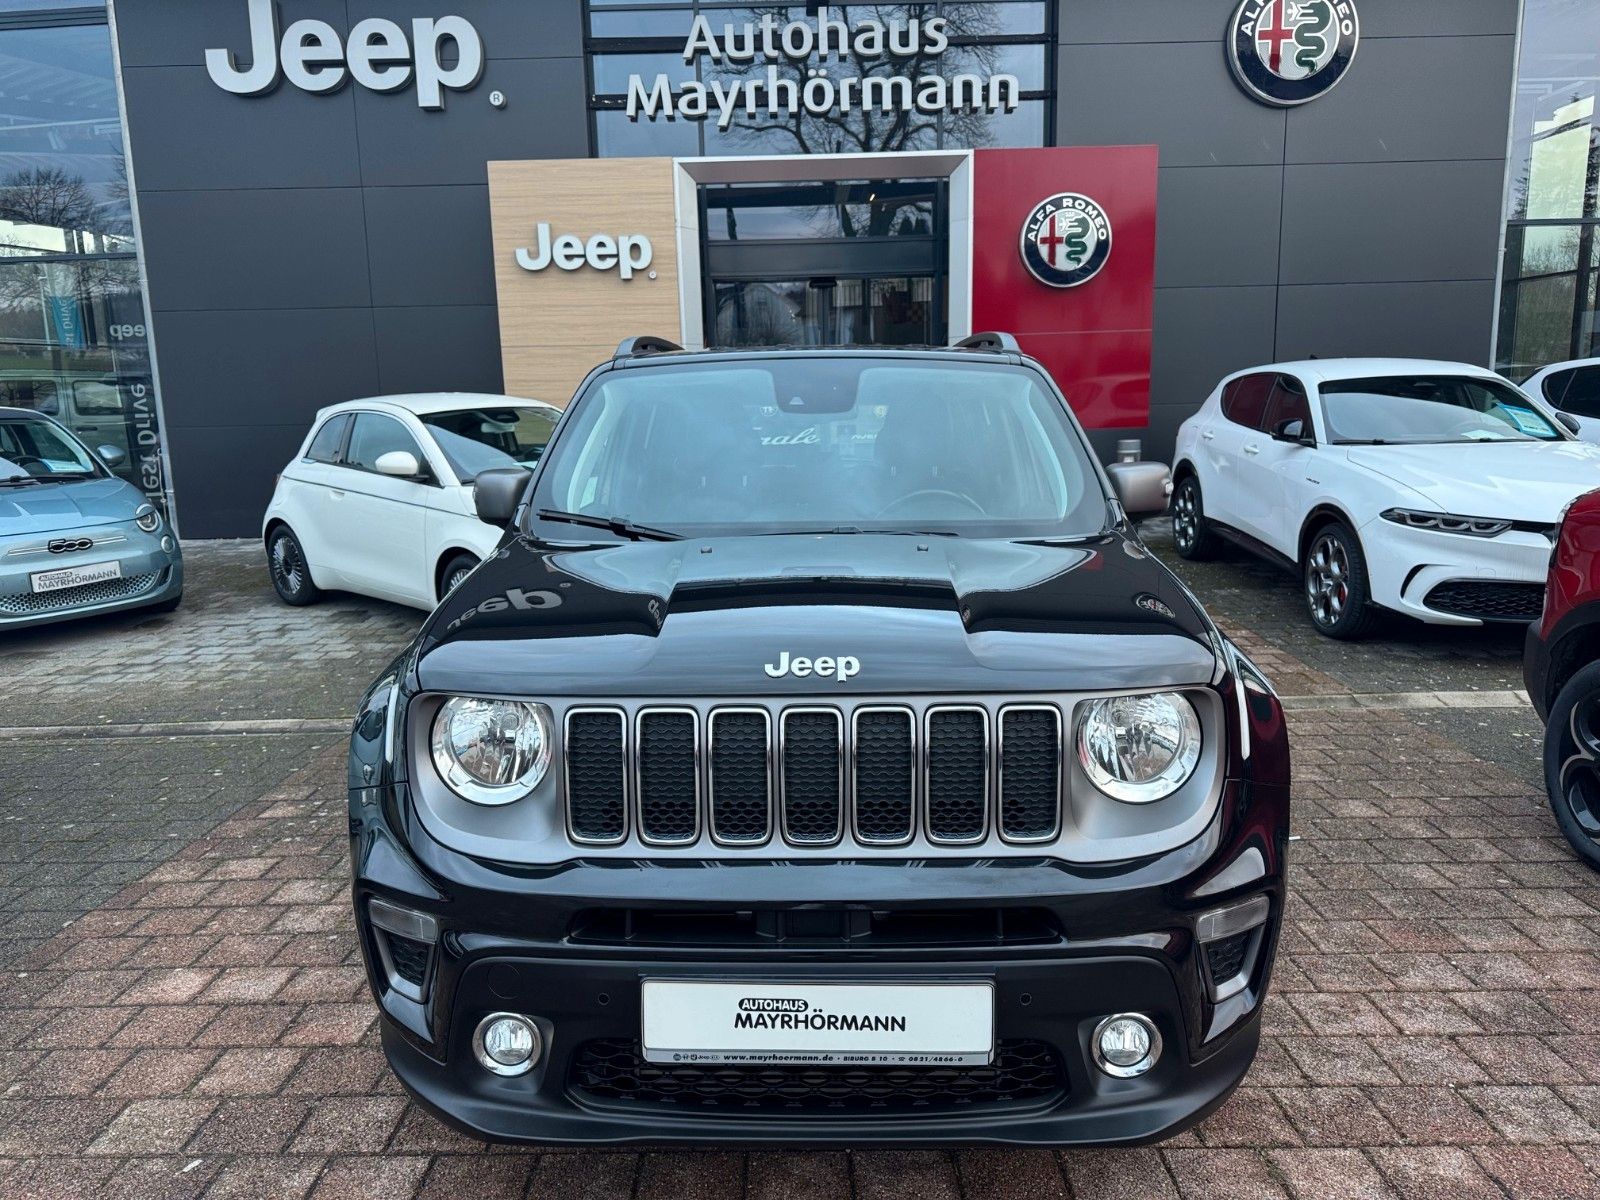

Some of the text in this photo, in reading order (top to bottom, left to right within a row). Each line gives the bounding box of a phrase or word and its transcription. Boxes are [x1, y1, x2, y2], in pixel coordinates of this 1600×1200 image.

[683, 7, 949, 61] Autohaus
[205, 0, 483, 108] Jeep
[625, 66, 1019, 128] Mayrhörmann
[1027, 198, 1107, 241] ALFA ROMEO
[515, 223, 653, 279] Jeep
[38, 569, 117, 590] MAYRHÖRMANN
[764, 651, 860, 683] Jeep
[734, 1008, 906, 1032] MAYRHÖRMANN
[741, 999, 806, 1011] AUTOHAUS
[724, 1054, 834, 1062] www.mayrhoermann.de
